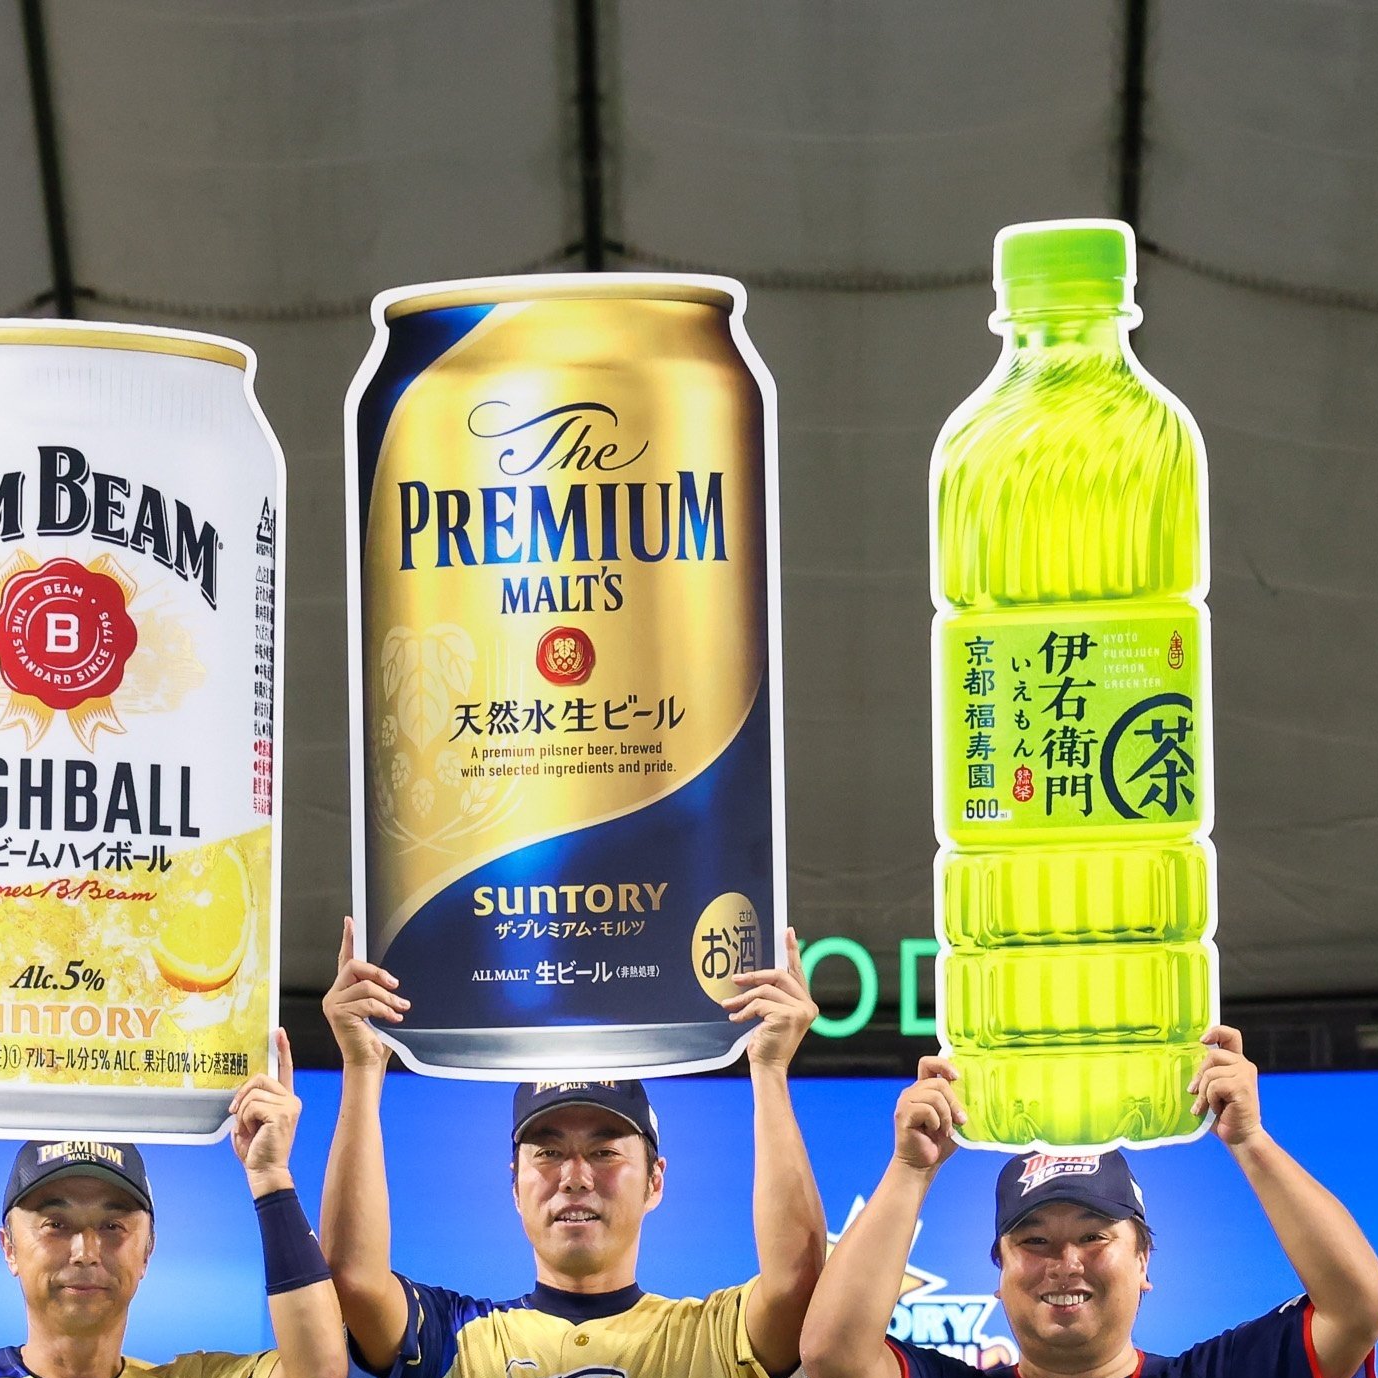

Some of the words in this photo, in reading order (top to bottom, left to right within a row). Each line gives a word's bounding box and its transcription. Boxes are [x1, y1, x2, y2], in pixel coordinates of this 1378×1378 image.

[468, 400, 649, 476] The
[37, 445, 219, 610] BEAM
[397, 470, 729, 572] PREMIUM
[43, 583, 84, 598] BEAM
[500, 566, 624, 615] MALT'S
[12, 608, 27, 633] THE
[45, 612, 79, 654] B
[99, 611, 113, 644] 1795
[12, 639, 72, 685] STANDARD
[76, 648, 110, 682] SINCE
[448, 694, 686, 742] 天然水生ビール
[1012, 656, 1034, 759] いえもん
[1037, 631, 1098, 818] 伊右衛門
[461, 764, 485, 778] with
[489, 762, 540, 777] selected
[543, 760, 614, 778] ingredients
[618, 760, 641, 774] and
[644, 759, 677, 776] pride.
[471, 746, 479, 759] A
[482, 746, 535, 761] premium
[539, 743, 583, 760] pilsner
[620, 740, 663, 755] brewed
[472, 882, 669, 918] SUNTORY
[701, 923, 758, 980] お酒
